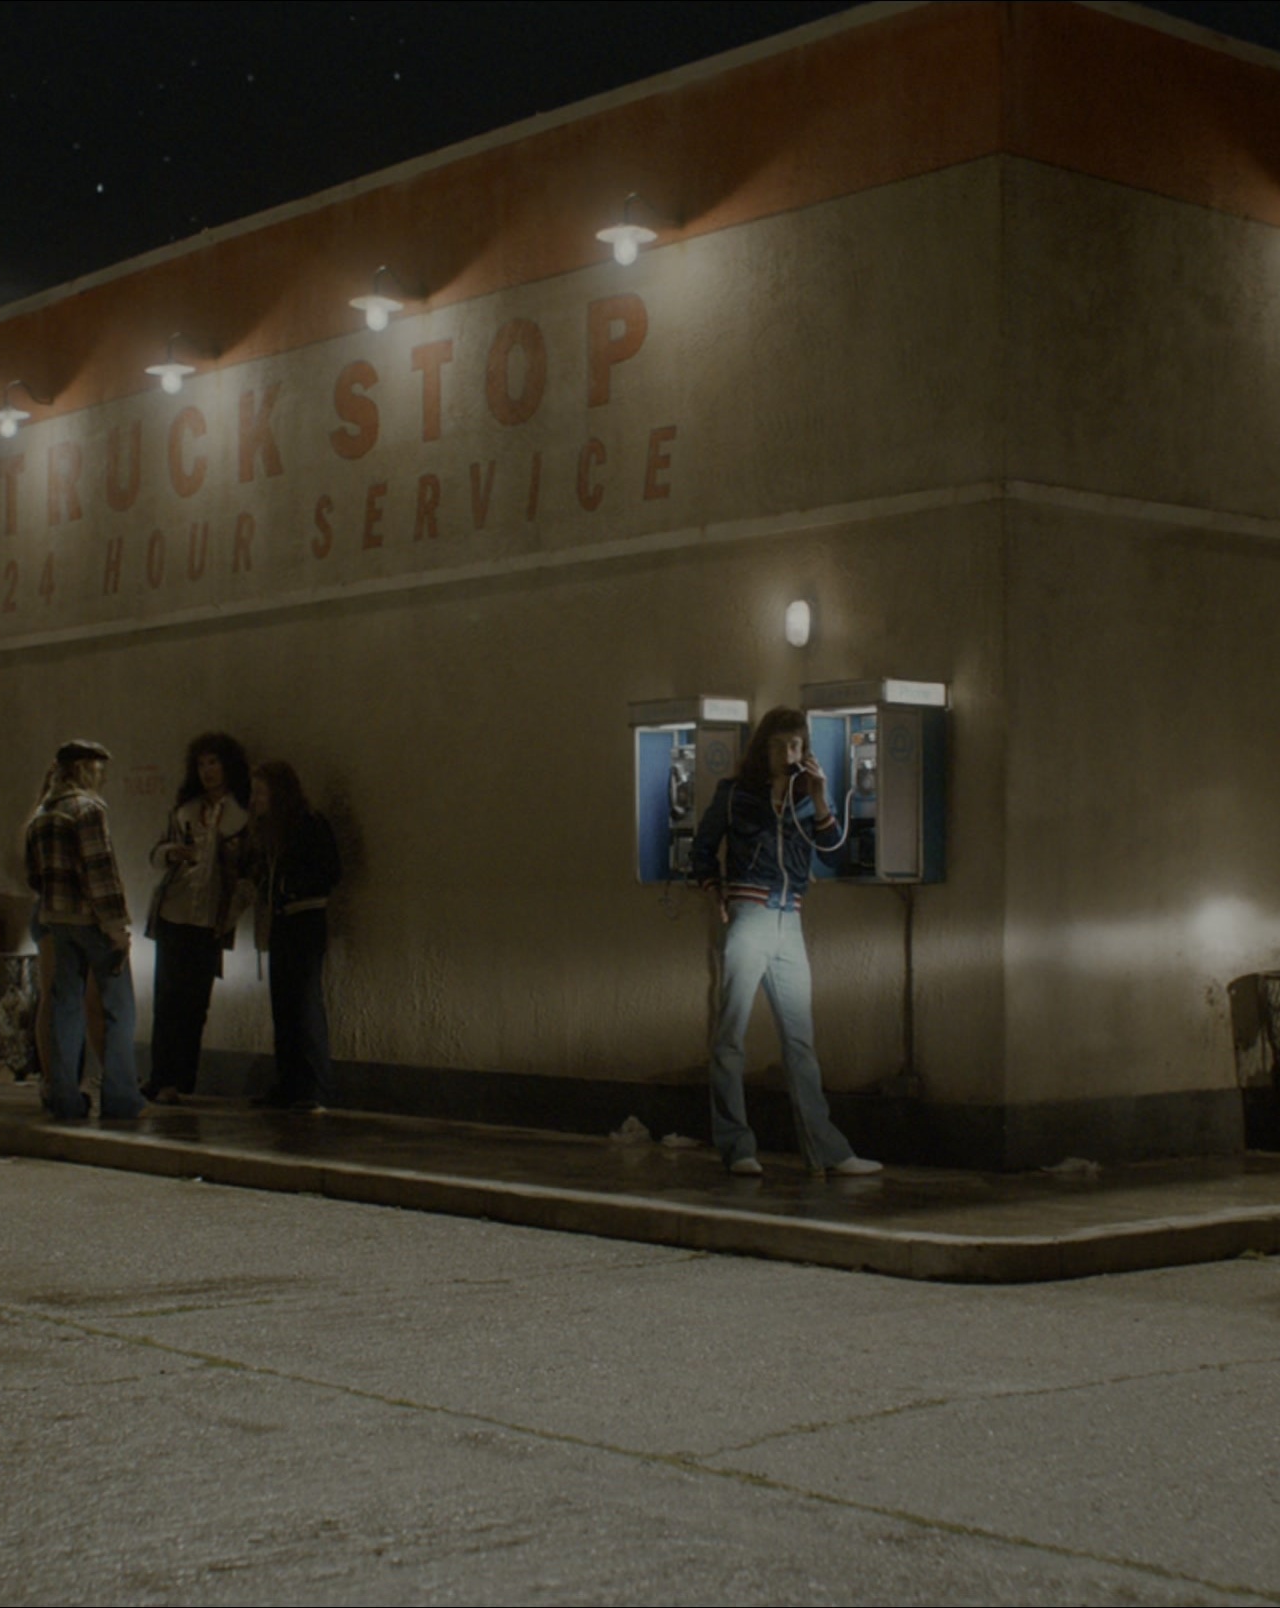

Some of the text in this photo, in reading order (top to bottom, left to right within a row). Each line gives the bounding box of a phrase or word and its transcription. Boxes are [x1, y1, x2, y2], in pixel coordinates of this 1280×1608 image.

[330, 293, 648, 460] STOP
[2, 425, 676, 614] 24 HOUR SERVICE
